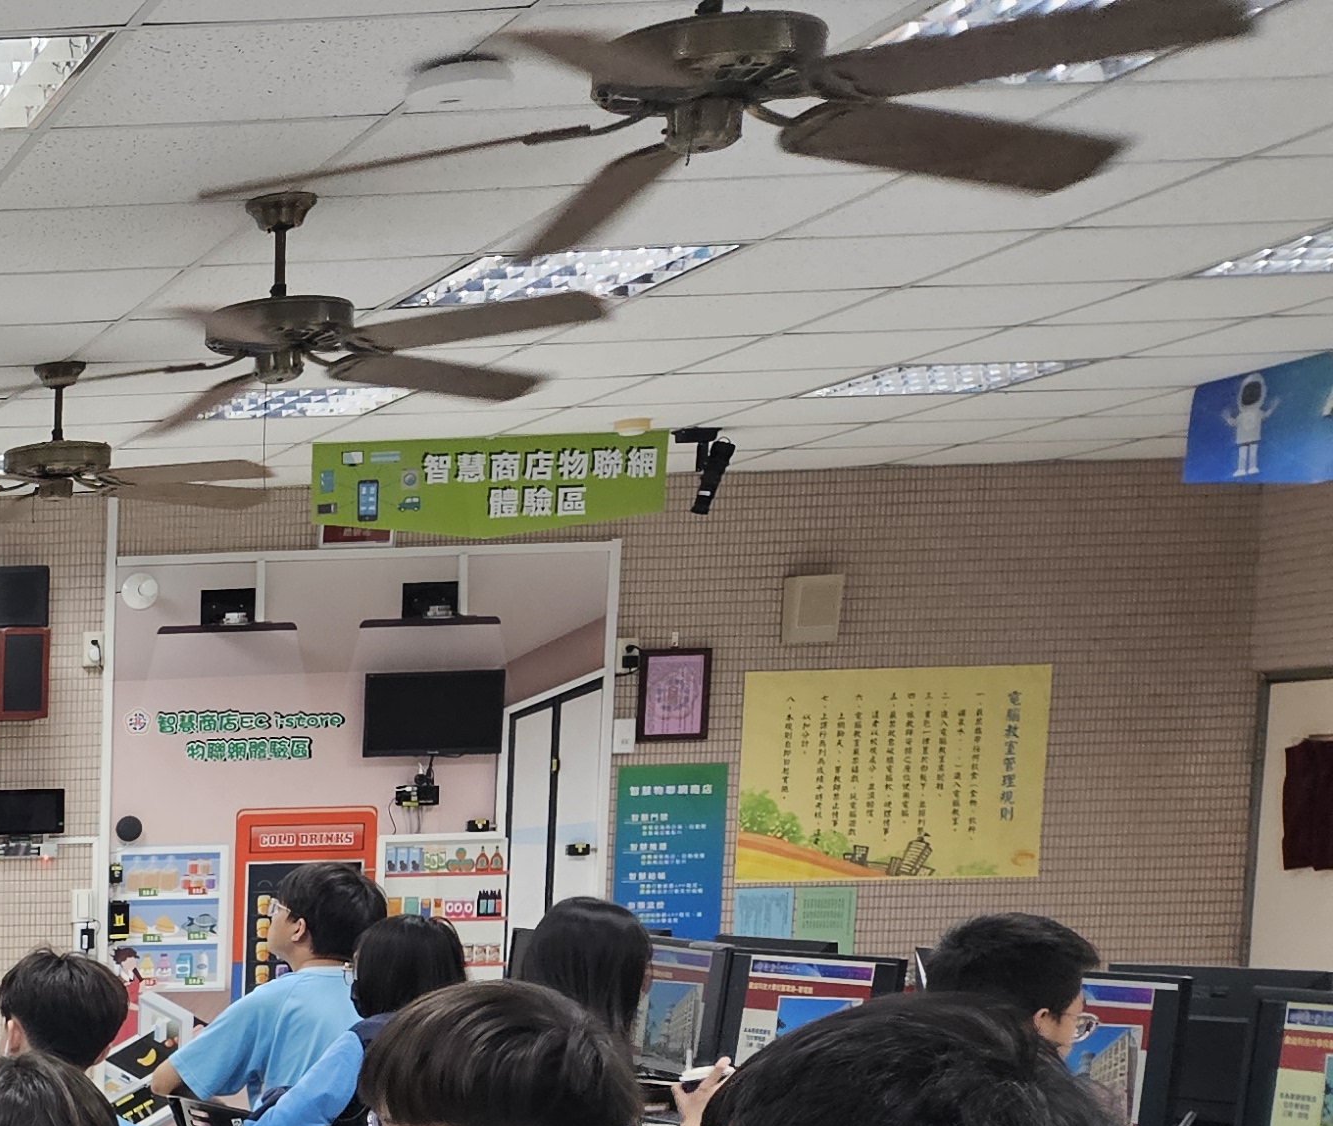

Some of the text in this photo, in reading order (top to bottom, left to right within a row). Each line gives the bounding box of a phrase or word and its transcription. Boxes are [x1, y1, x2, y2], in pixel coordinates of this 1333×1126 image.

[422, 447, 658, 485] 智慧商店物聯網
[487, 485, 588, 519] 體驗區
[186, 737, 313, 761] 物聯網體驗區
[1000, 690, 1023, 821] 電腦教室管理規則
[259, 832, 354, 847] COLD DRINKS
